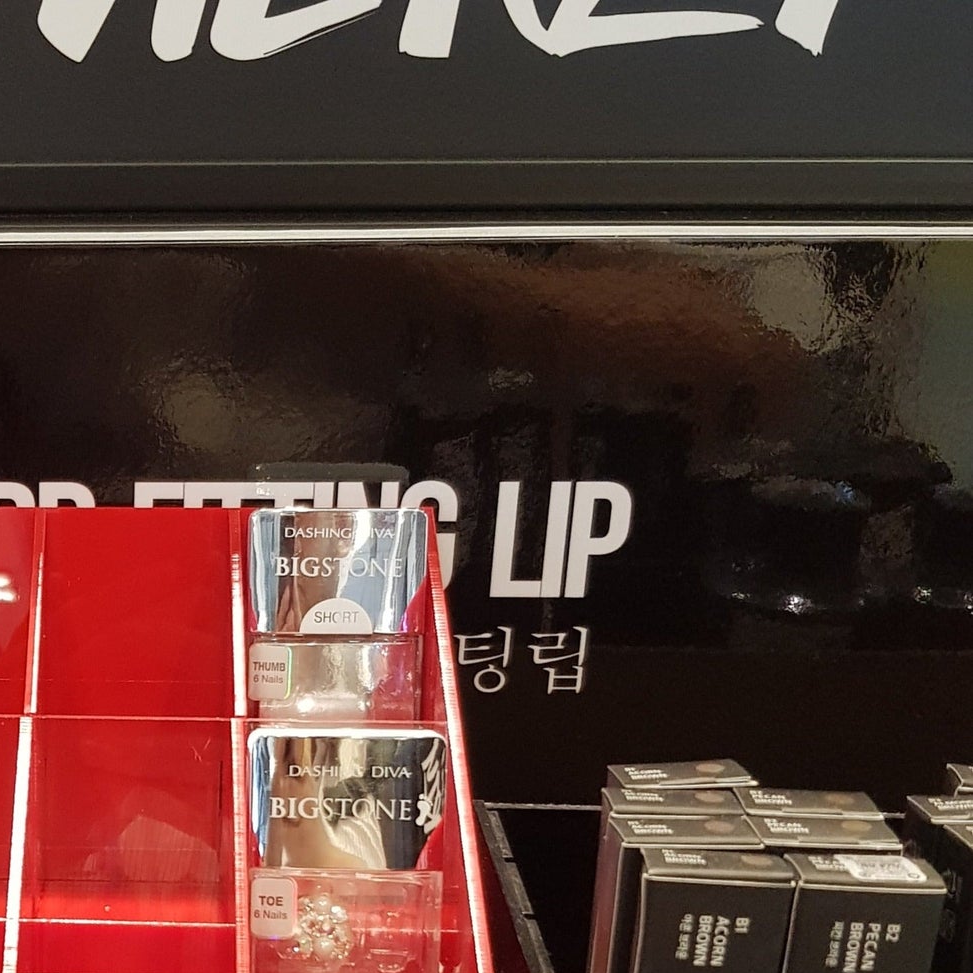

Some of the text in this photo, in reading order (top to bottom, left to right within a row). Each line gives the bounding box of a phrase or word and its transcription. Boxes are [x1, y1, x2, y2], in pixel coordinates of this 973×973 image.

[284, 527, 352, 539] DASHING
[489, 480, 633, 599] LIP
[253, 661, 286, 672] THUMB
[253, 675, 284, 684] 6 Nails
[371, 766, 413, 779] DIVA
[270, 796, 412, 821] BIGSTONE
[258, 895, 284, 907] TOE
[253, 910, 288, 920] 6 Nails
[734, 917, 750, 934] B1
[885, 923, 902, 943] B2
[692, 915, 714, 967] BROWN
[710, 915, 731, 967] ACORN
[842, 921, 865, 973] BROWN
[860, 922, 882, 972] PECAN
